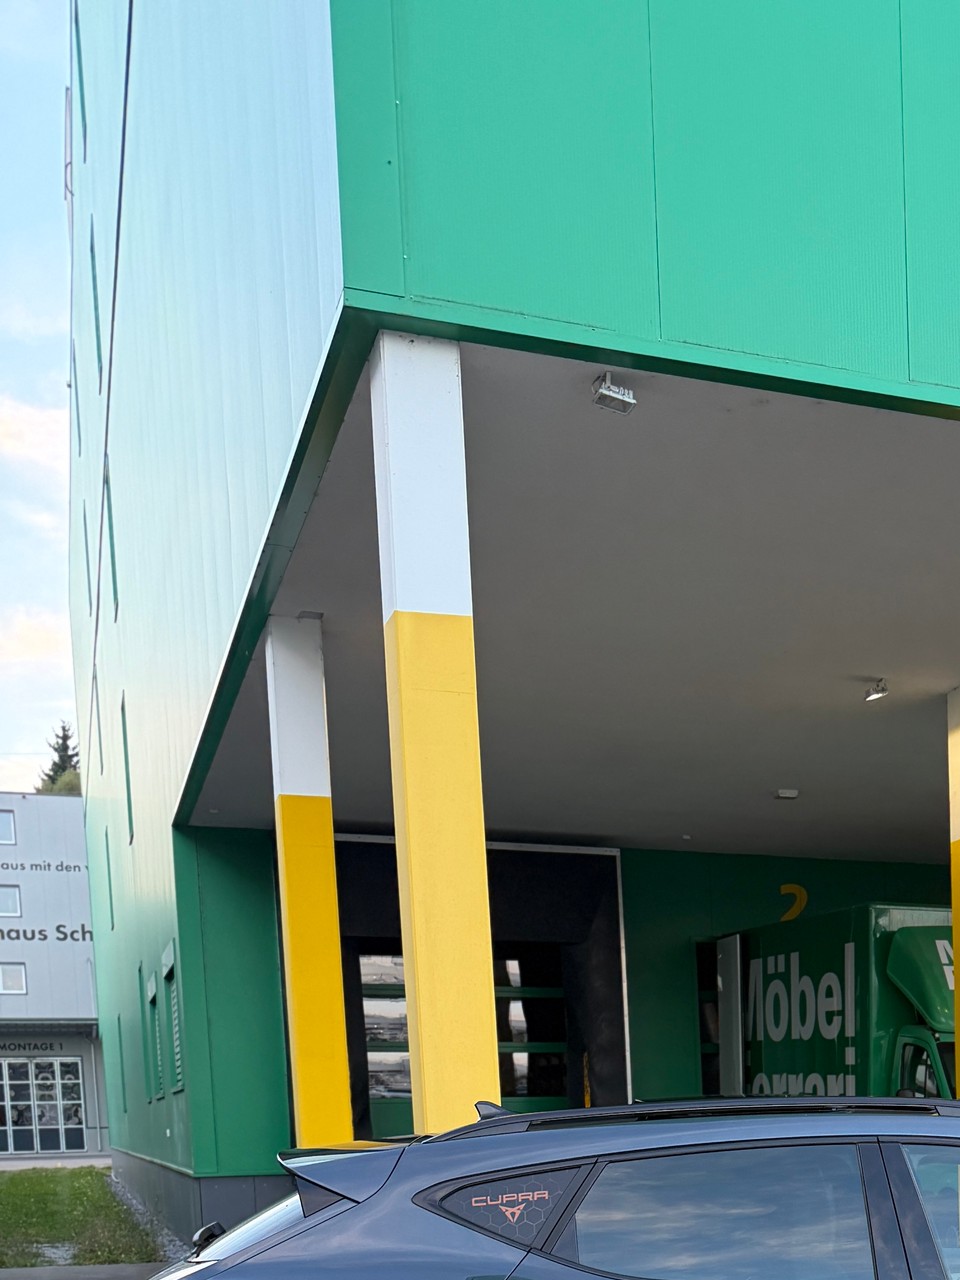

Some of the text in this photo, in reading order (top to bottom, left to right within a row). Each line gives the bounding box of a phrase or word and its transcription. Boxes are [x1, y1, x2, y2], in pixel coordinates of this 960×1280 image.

[30, 860, 52, 871] mit
[55, 861, 81, 872] den
[59, 1042, 63, 1051] 1
[471, 1190, 549, 1207] CUPRA
